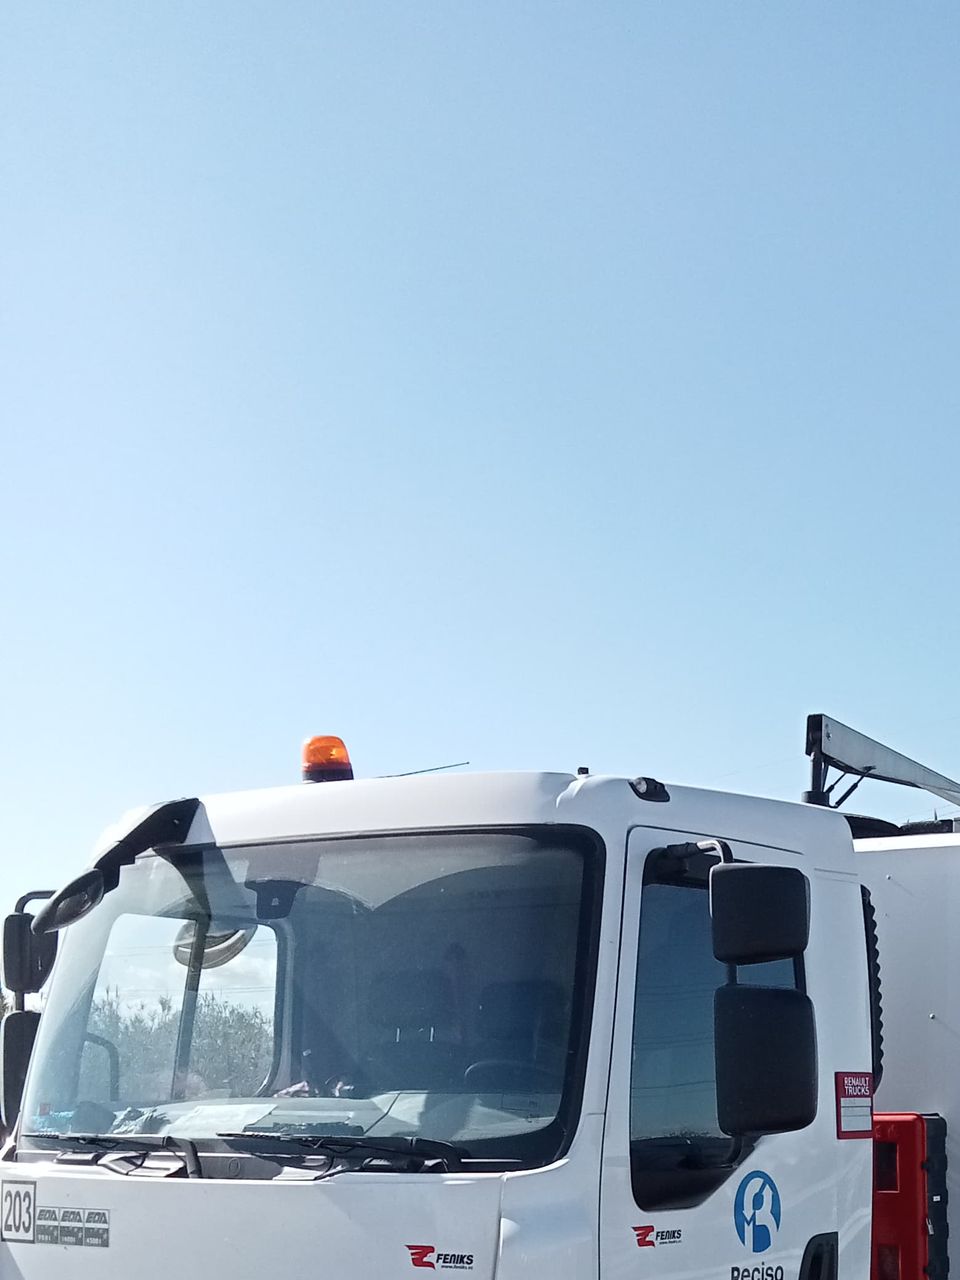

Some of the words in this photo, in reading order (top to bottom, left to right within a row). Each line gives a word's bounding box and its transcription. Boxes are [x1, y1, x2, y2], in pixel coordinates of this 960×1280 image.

[844, 1077, 869, 1087] RENAULT
[845, 1086, 870, 1096] TRUCKS
[4, 1190, 31, 1233] 203
[656, 1229, 682, 1241] FENIKS
[436, 1253, 474, 1266] FENIKS
